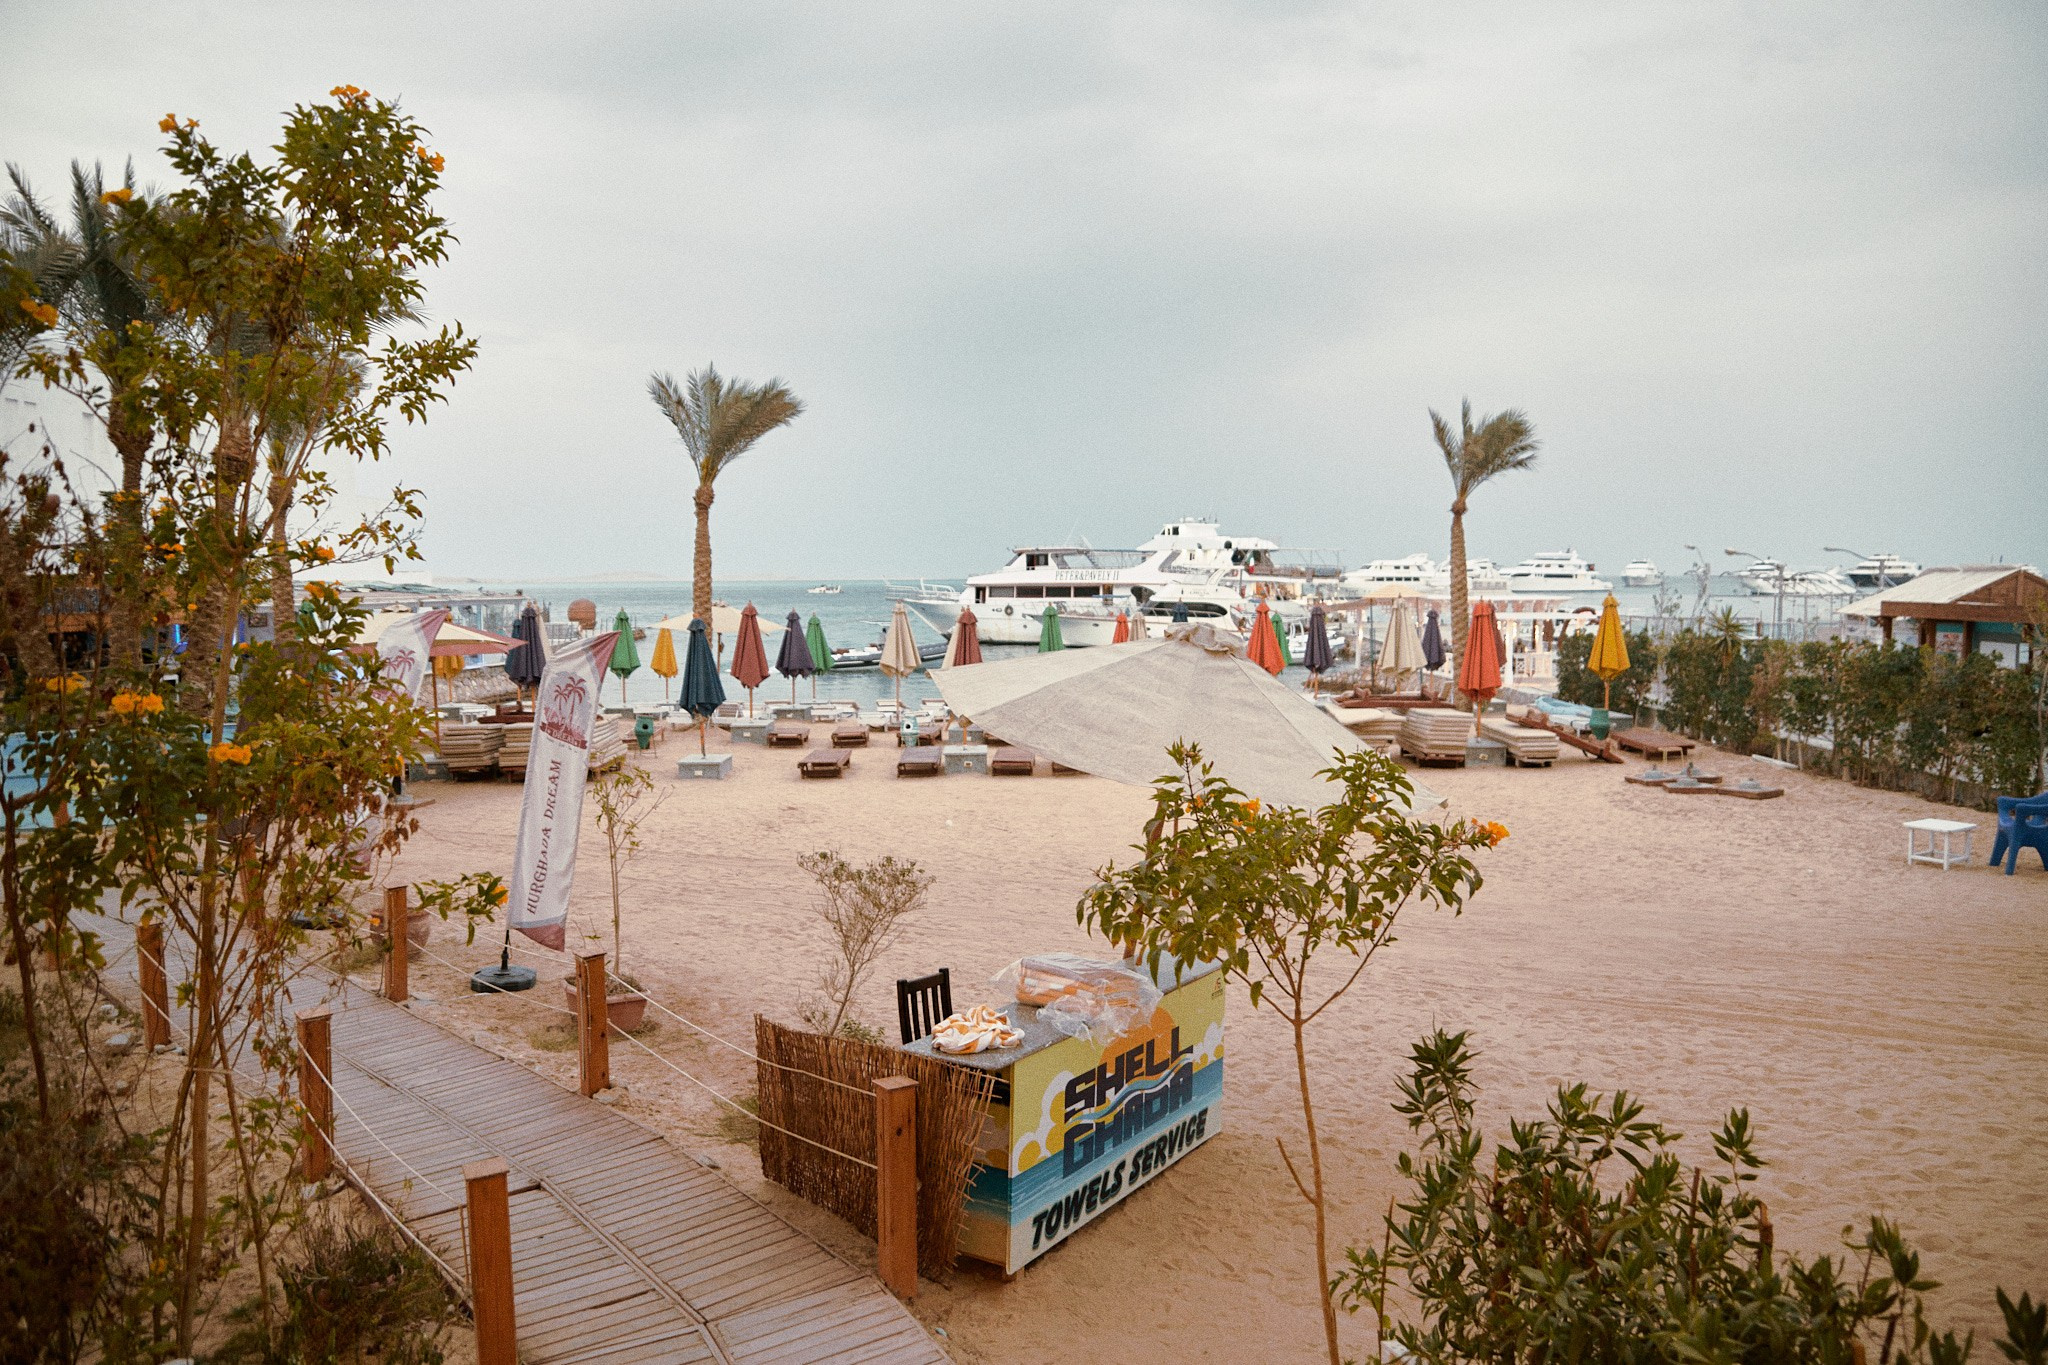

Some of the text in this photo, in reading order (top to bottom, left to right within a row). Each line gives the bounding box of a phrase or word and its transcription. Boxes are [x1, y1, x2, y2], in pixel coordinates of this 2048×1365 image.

[526, 826, 552, 915] HURGHADA
[543, 760, 562, 820] DREAM
[1062, 1061, 1194, 1180] GHADA
[1064, 1026, 1194, 1124] SHELL
[1032, 1107, 1209, 1250] TOWELS SERVICE
